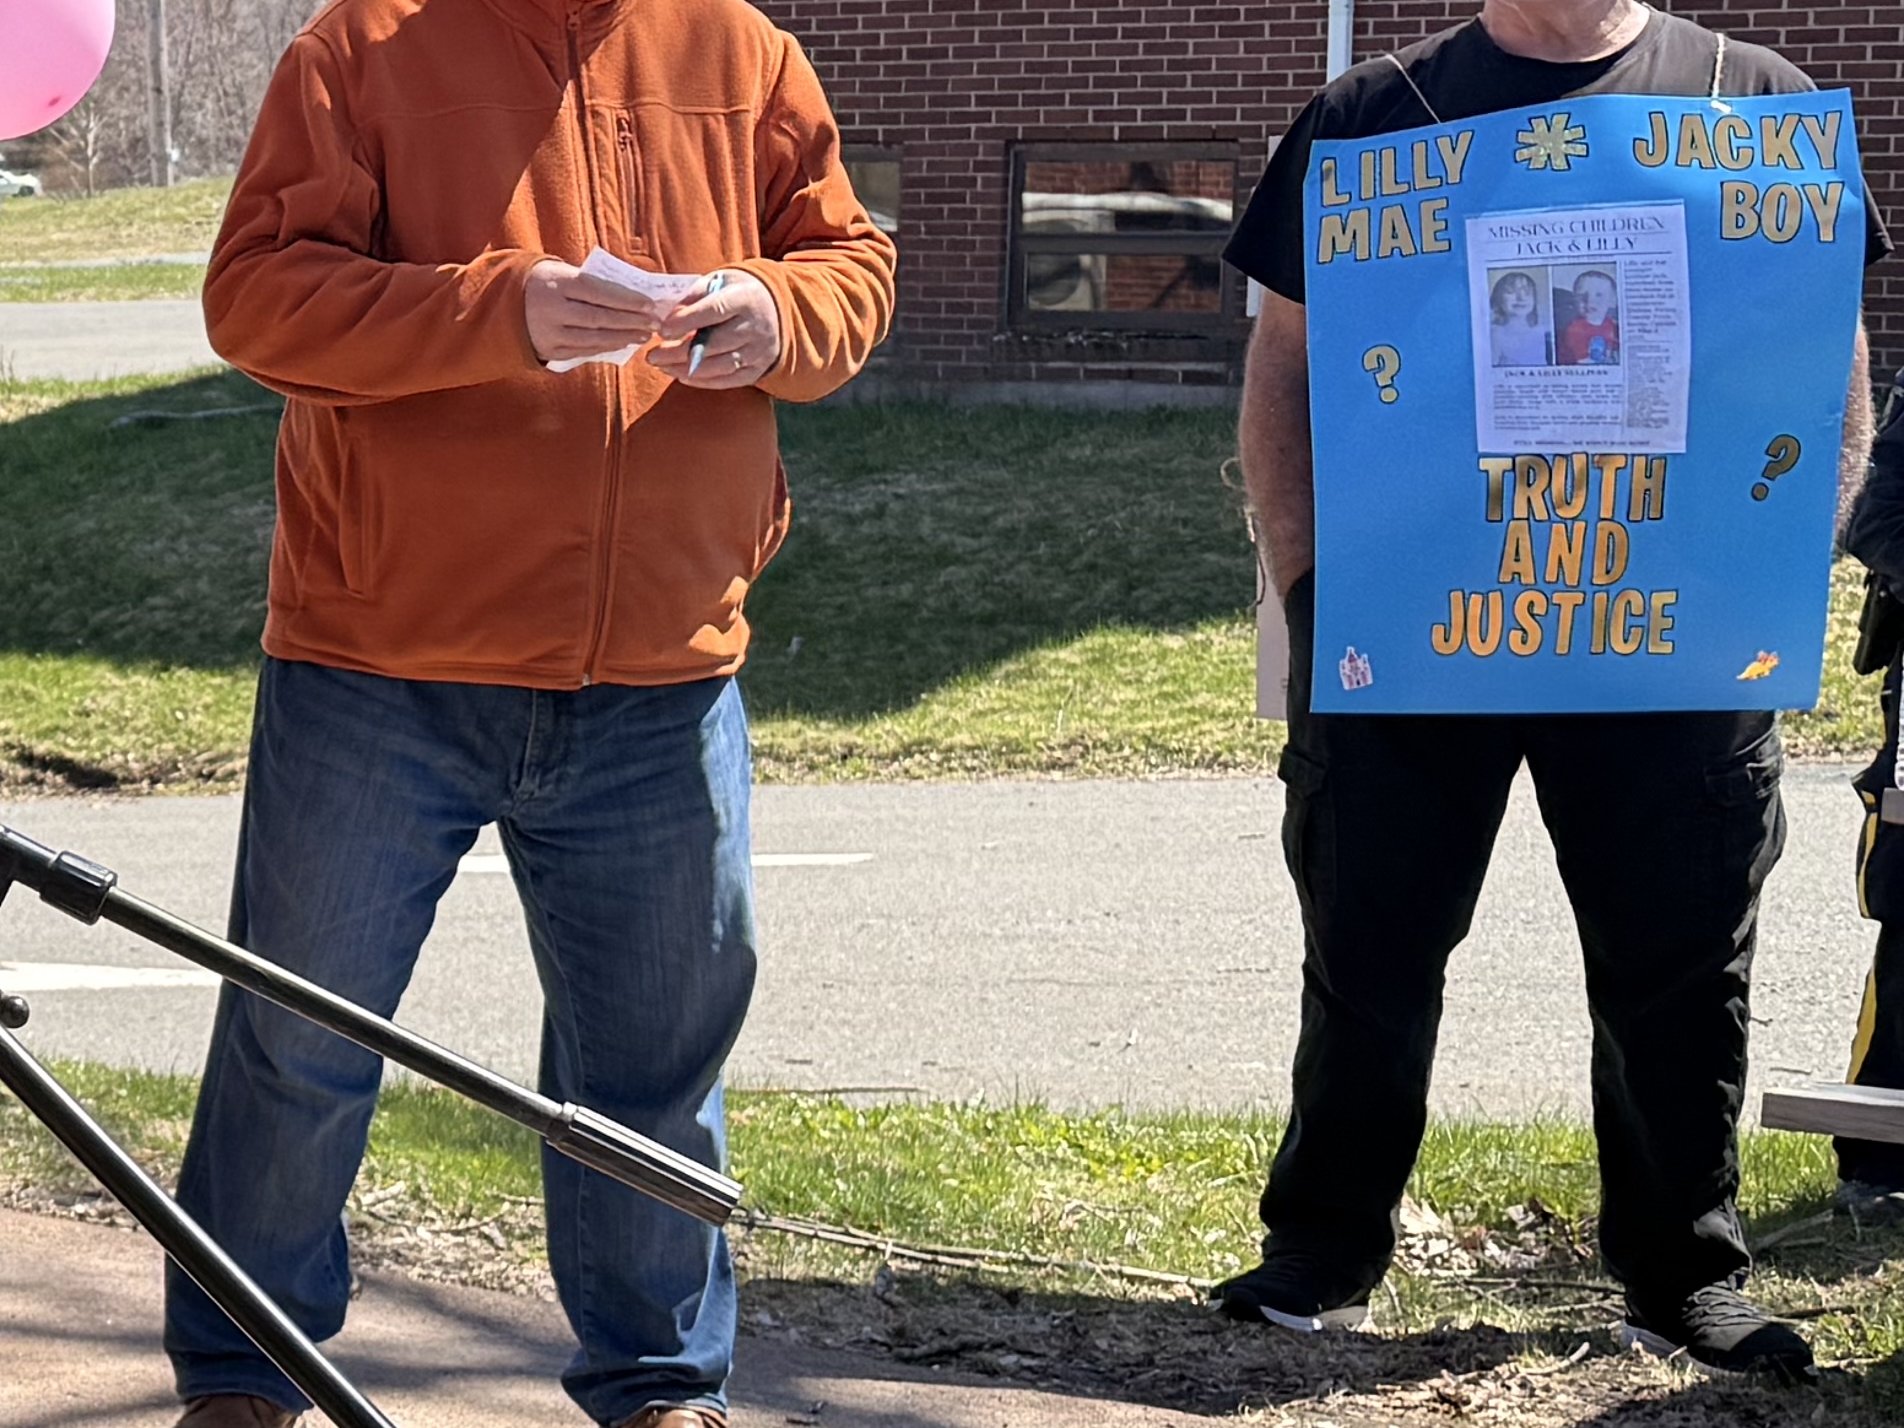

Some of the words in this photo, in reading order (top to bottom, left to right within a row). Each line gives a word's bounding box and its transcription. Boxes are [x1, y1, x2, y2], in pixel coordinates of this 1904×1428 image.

[1321, 128, 1476, 208] LILLY
[1633, 110, 1843, 171] JACKY
[1317, 197, 1452, 264] MAE
[1720, 180, 1845, 244] BOY
[1489, 219, 1565, 239] MISSING
[1568, 216, 1665, 235] CHILDREN
[1517, 239, 1562, 256] JACK
[1567, 239, 1583, 253] &
[1586, 236, 1638, 252] LILLY
[1362, 345, 1402, 404] ?
[1479, 452, 1667, 522] TRUTH
[1751, 435, 1801, 502] ?
[1499, 520, 1630, 587] AND
[1430, 589, 1678, 657] JUSTICE
